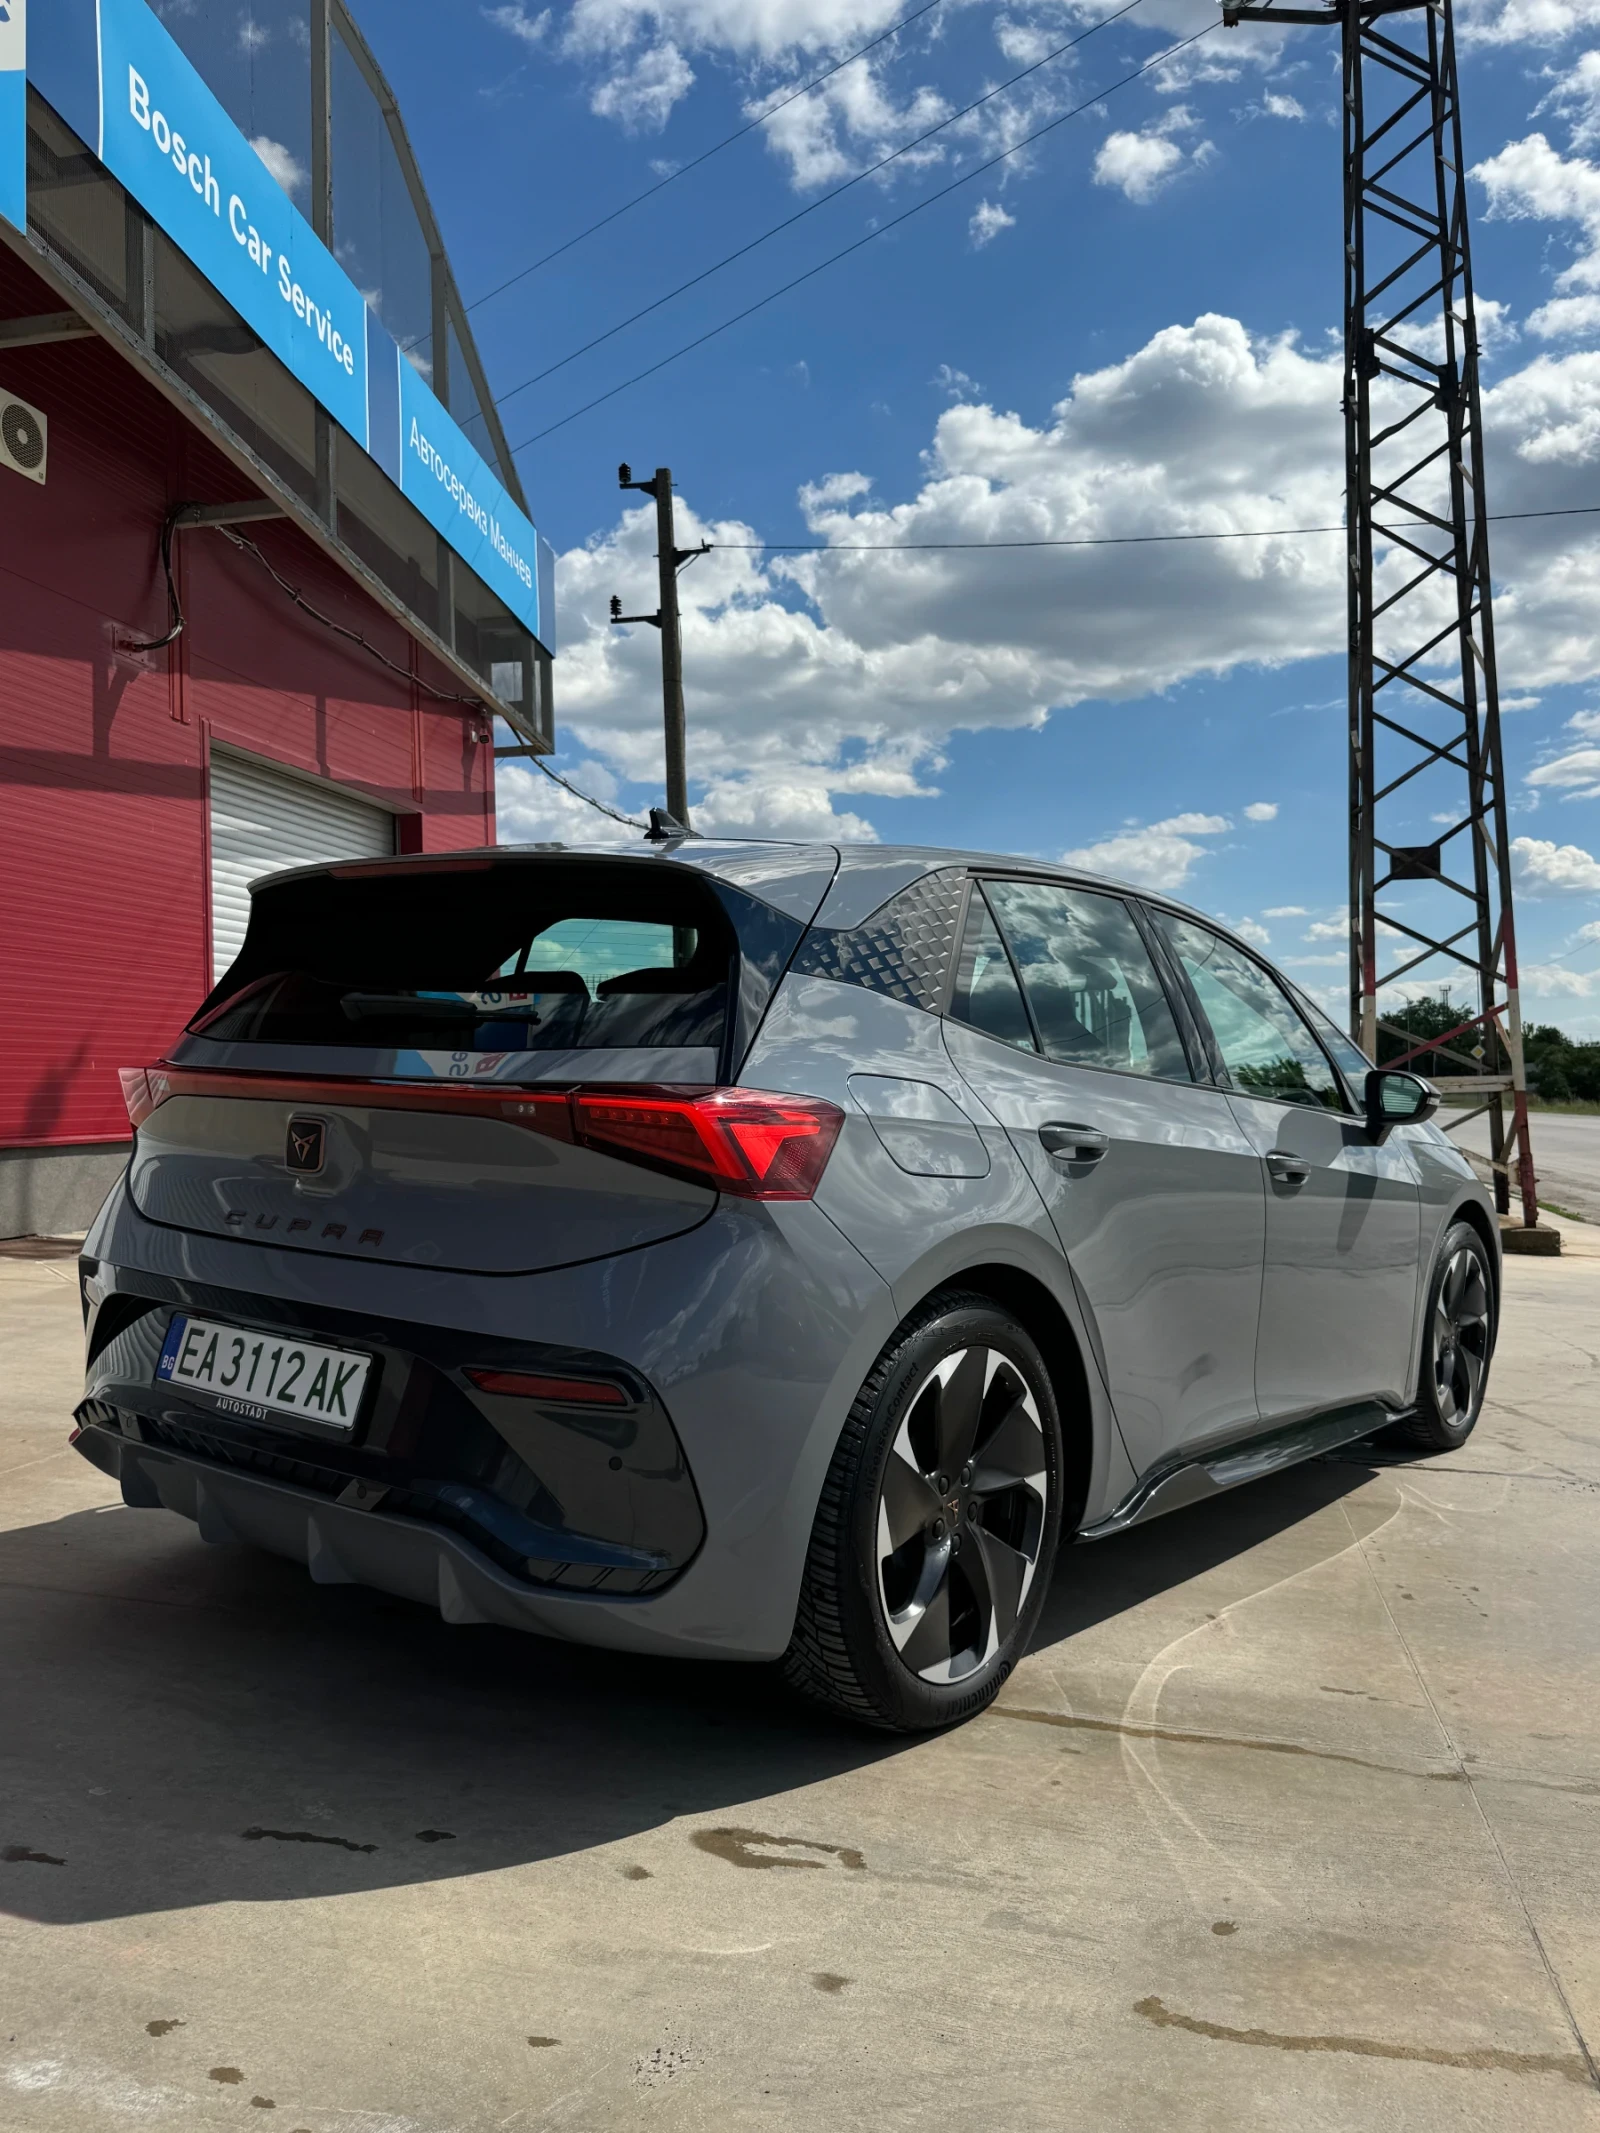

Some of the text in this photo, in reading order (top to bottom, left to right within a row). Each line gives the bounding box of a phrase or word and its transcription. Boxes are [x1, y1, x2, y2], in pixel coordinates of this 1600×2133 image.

[129, 63, 354, 375] Bosch Car Service
[409, 416, 532, 589] Автосервиз Манчев
[224, 1209, 386, 1247] CUPRA
[161, 1354, 175, 1370] BG
[216, 1397, 268, 1420] AUTOSTADT
[944, 1660, 1012, 1721] Continental
